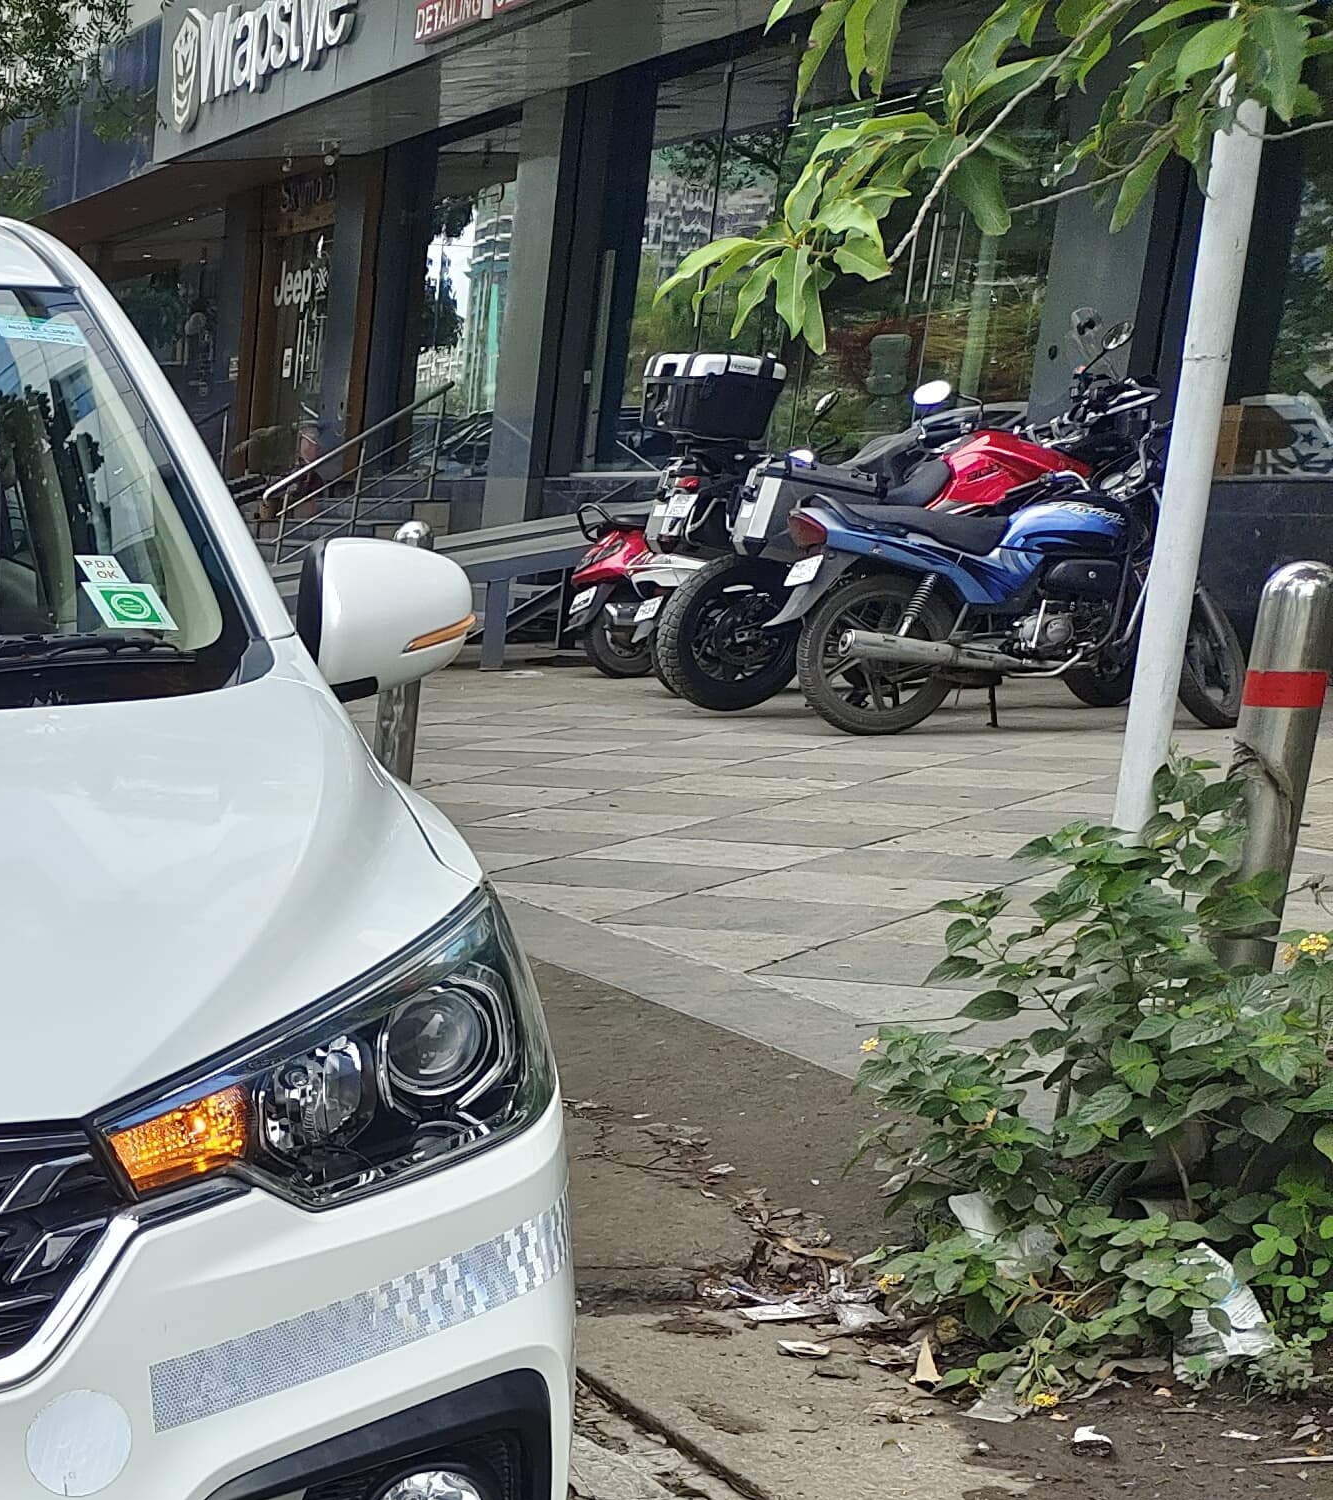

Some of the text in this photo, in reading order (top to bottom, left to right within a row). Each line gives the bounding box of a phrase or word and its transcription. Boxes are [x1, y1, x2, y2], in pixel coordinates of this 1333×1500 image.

[414, 0, 481, 39] DETAILING
[187, 0, 356, 104] Wrapstyle
[274, 260, 312, 313] Jeep
[96, 570, 119, 579] OK
